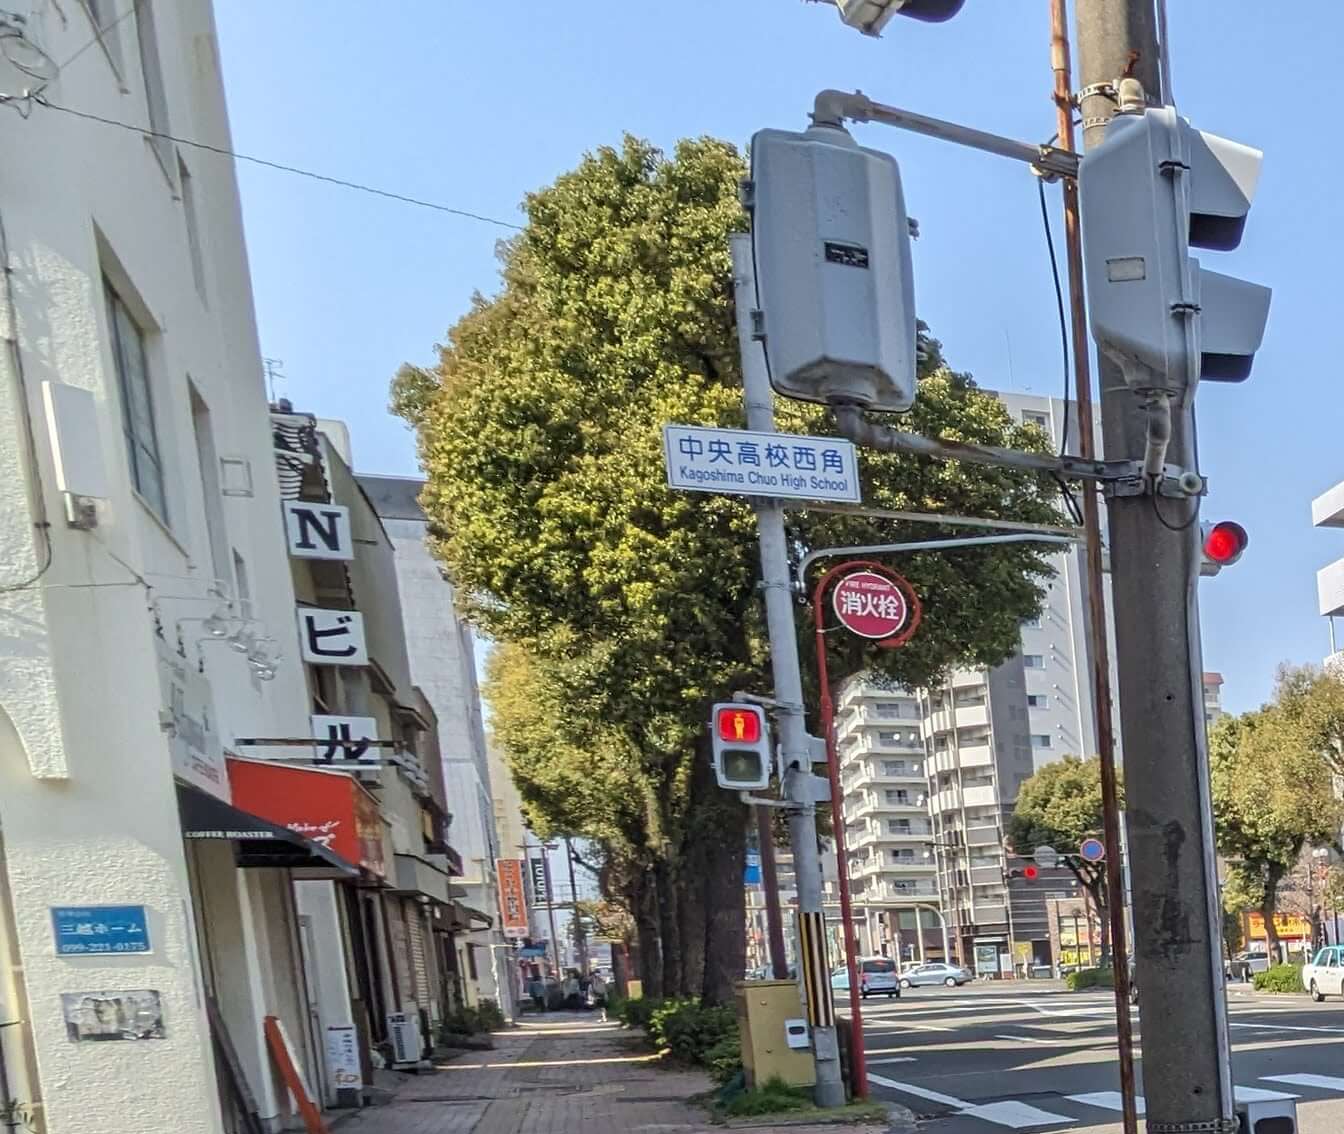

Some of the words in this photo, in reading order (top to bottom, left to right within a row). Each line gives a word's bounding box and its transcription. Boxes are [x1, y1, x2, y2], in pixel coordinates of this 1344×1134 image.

[679, 435, 845, 475] 中央高校西角
[680, 465, 745, 484] Kagoshima
[748, 471, 778, 487] Chuo
[781, 475, 807, 491] High
[810, 477, 848, 492] School
[840, 590, 900, 620] 消火栓
[185, 831, 225, 839] COFFEE
[226, 831, 274, 839] ROASTER
